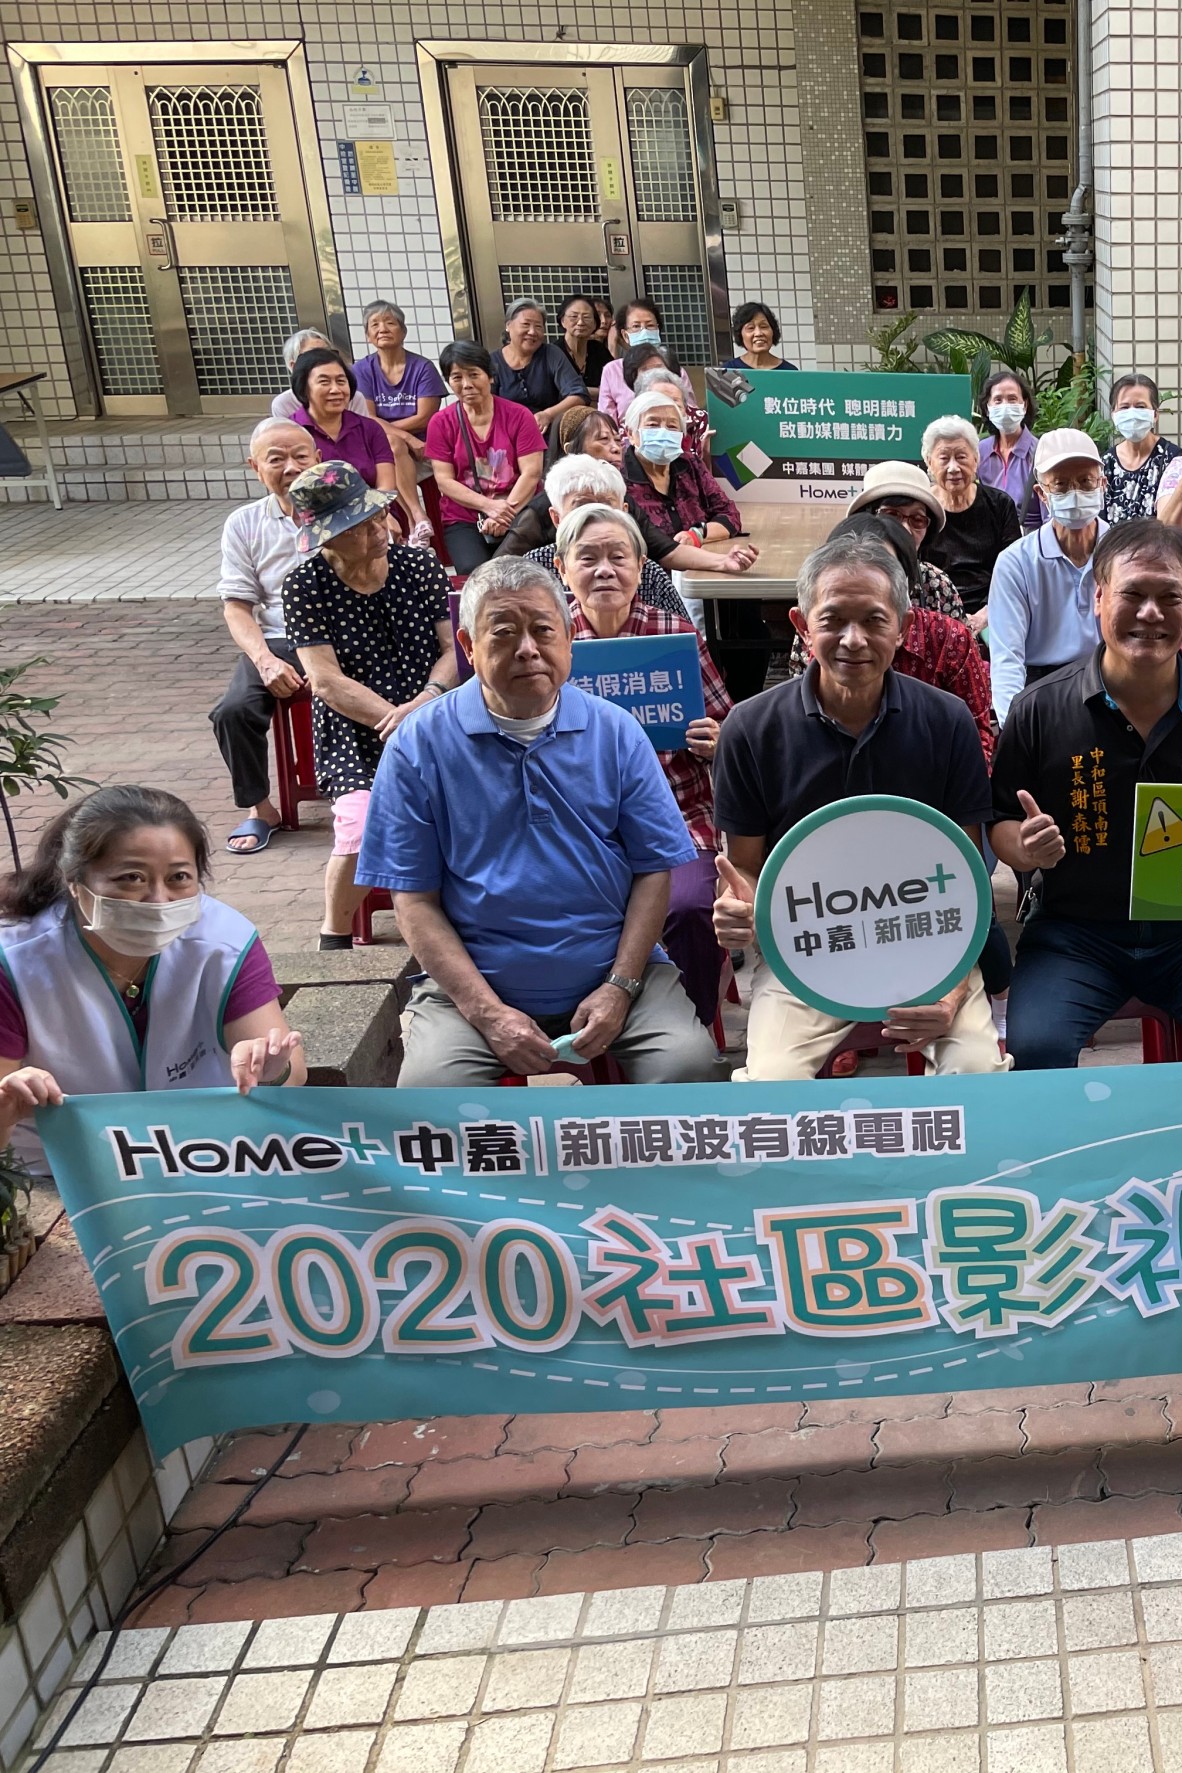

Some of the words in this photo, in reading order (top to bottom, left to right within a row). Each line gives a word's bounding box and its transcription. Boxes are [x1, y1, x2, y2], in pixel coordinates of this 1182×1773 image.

[613, 236, 626, 248] 拉
[764, 396, 835, 416] 數位時代
[844, 399, 917, 418] 聰明識讀
[779, 420, 903, 442] 啟動媒體識讀力
[782, 461, 835, 476] 中嘉集團
[631, 702, 684, 725] NEWS
[1090, 747, 1108, 846] 中和區頂南里
[793, 924, 856, 957] 中嘉
[874, 907, 963, 945] 新視波
[398, 1122, 525, 1176] 中嘉
[557, 1108, 965, 1169] 新視波有線電視
